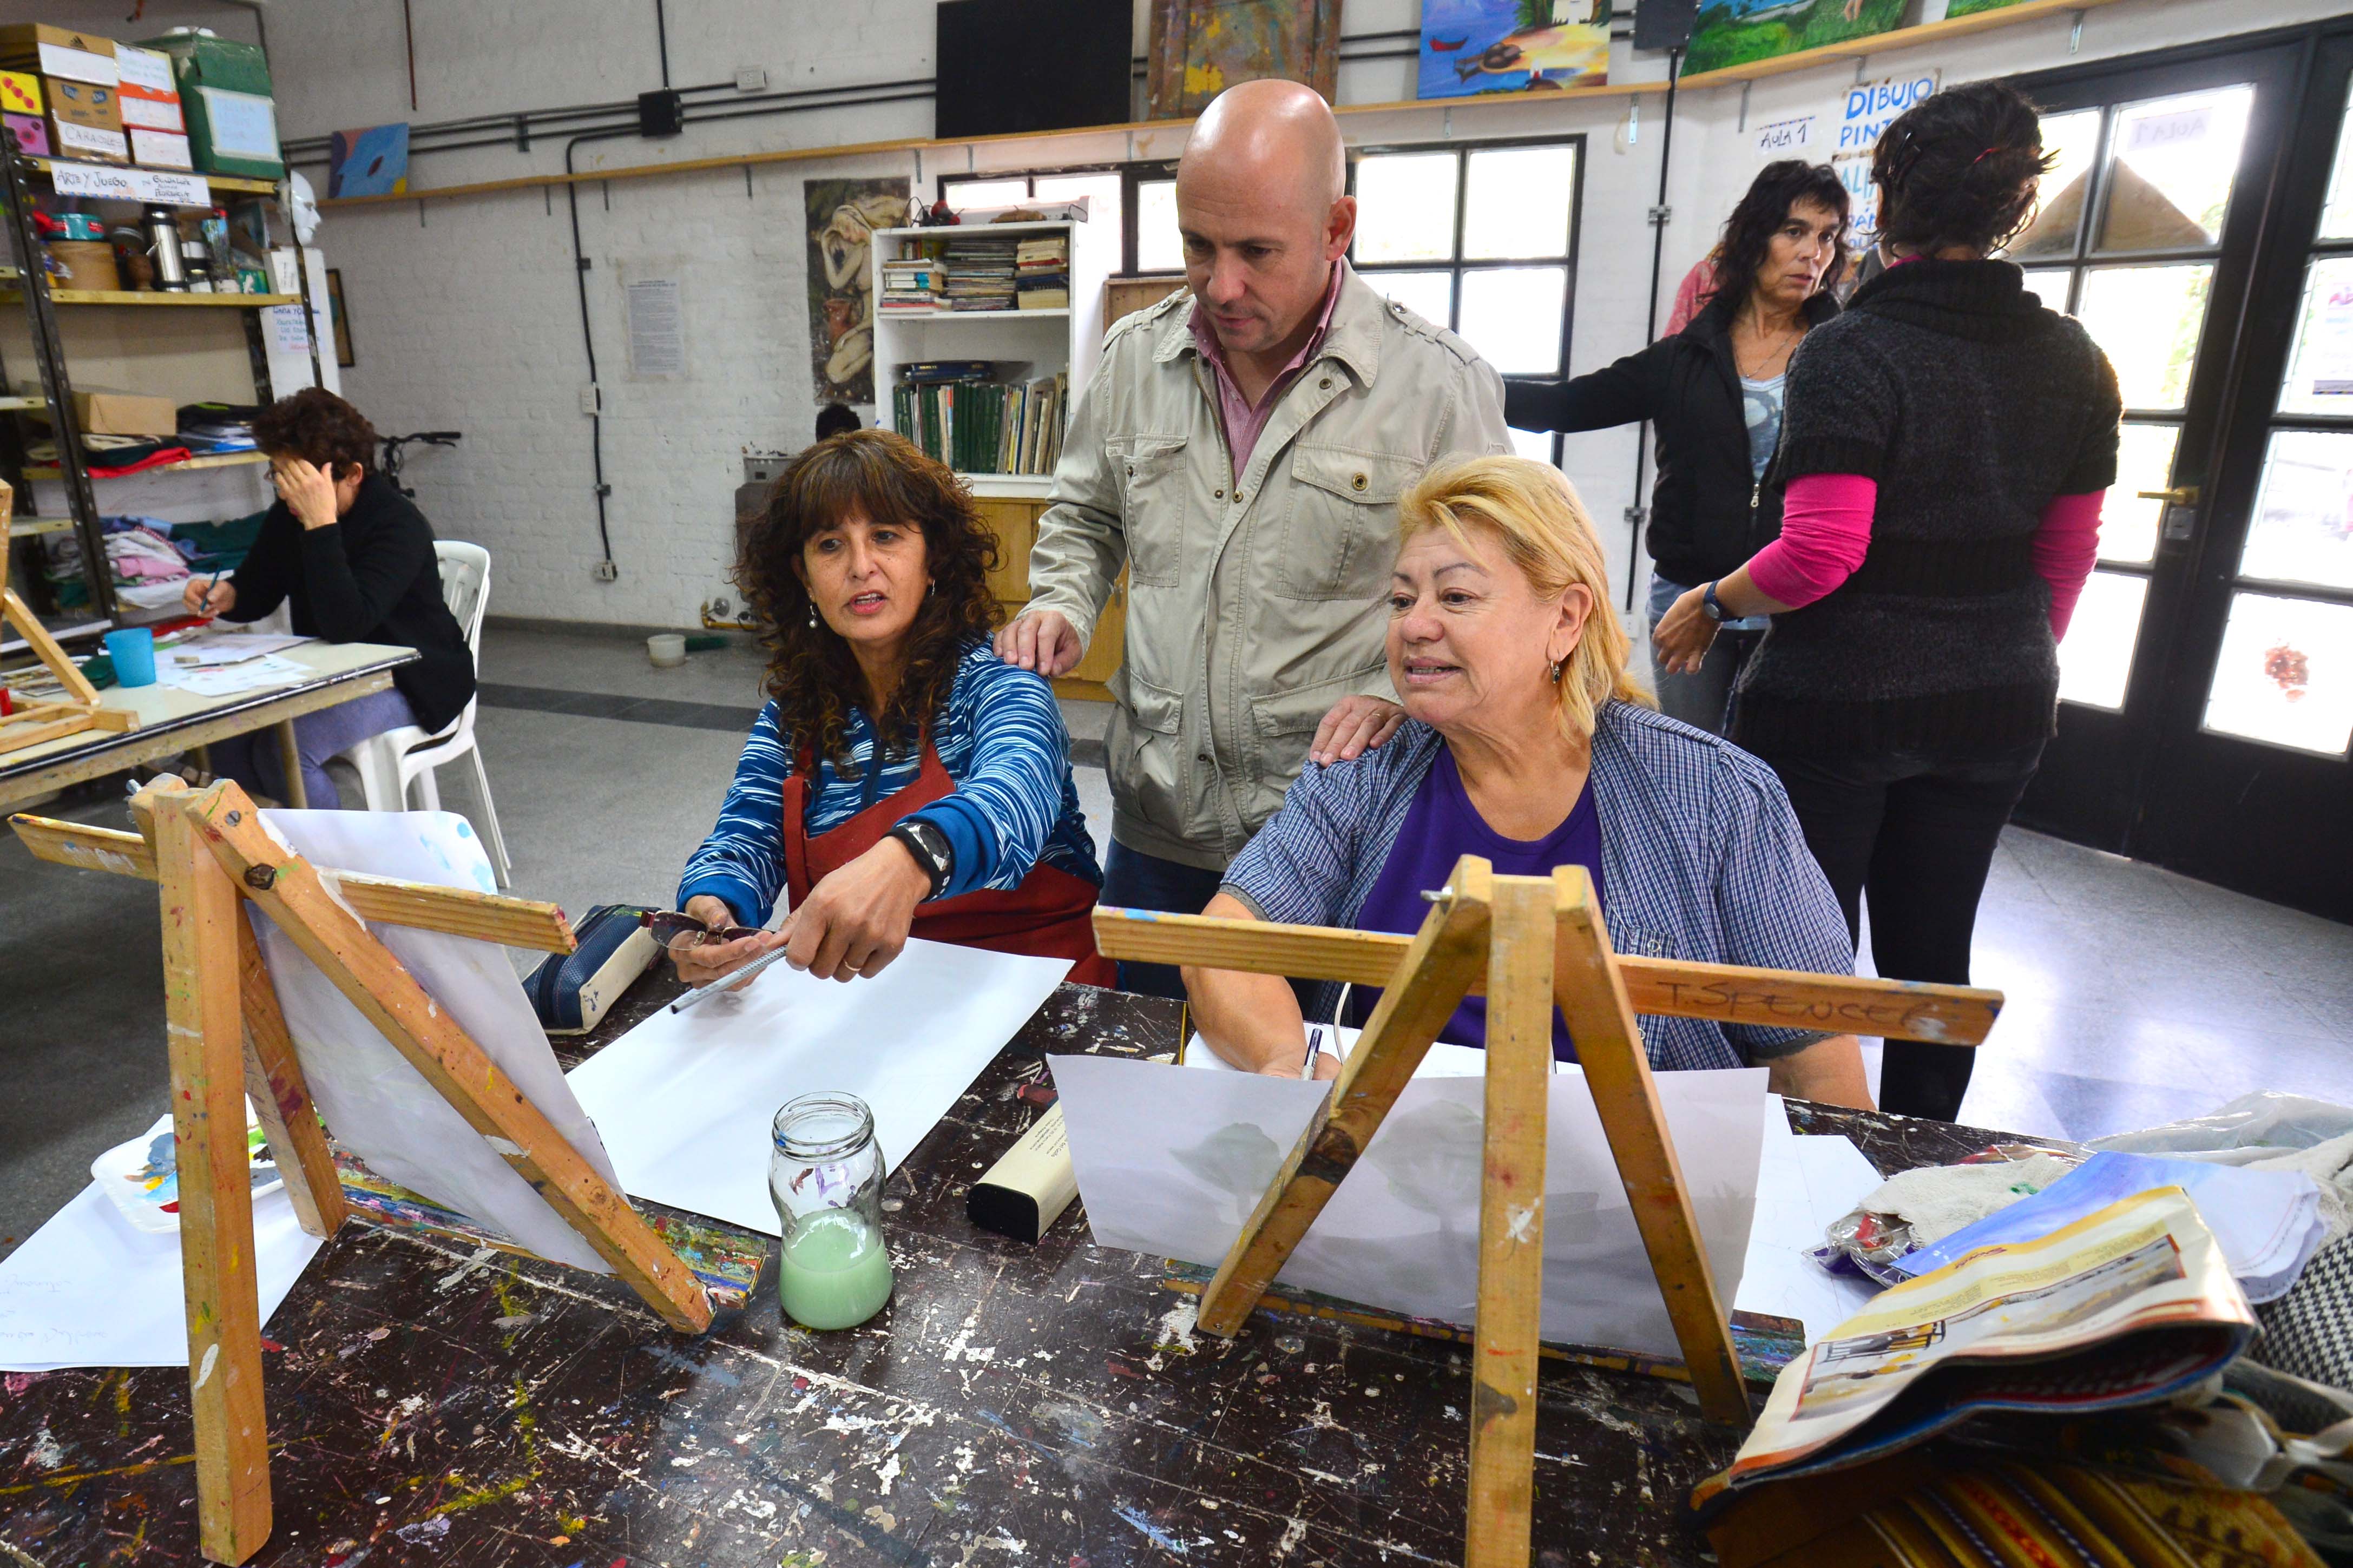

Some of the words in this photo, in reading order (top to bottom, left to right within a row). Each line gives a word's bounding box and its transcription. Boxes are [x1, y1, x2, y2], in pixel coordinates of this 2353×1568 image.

[1845, 78, 1934, 120] DIBUJO
[1760, 130, 1792, 148] AULA
[1797, 123, 1806, 143] 1
[1840, 118, 1894, 147] PINT
[57, 169, 81, 186] ARTE
[83, 172, 90, 188] Y
[93, 171, 127, 187] JUEGO
